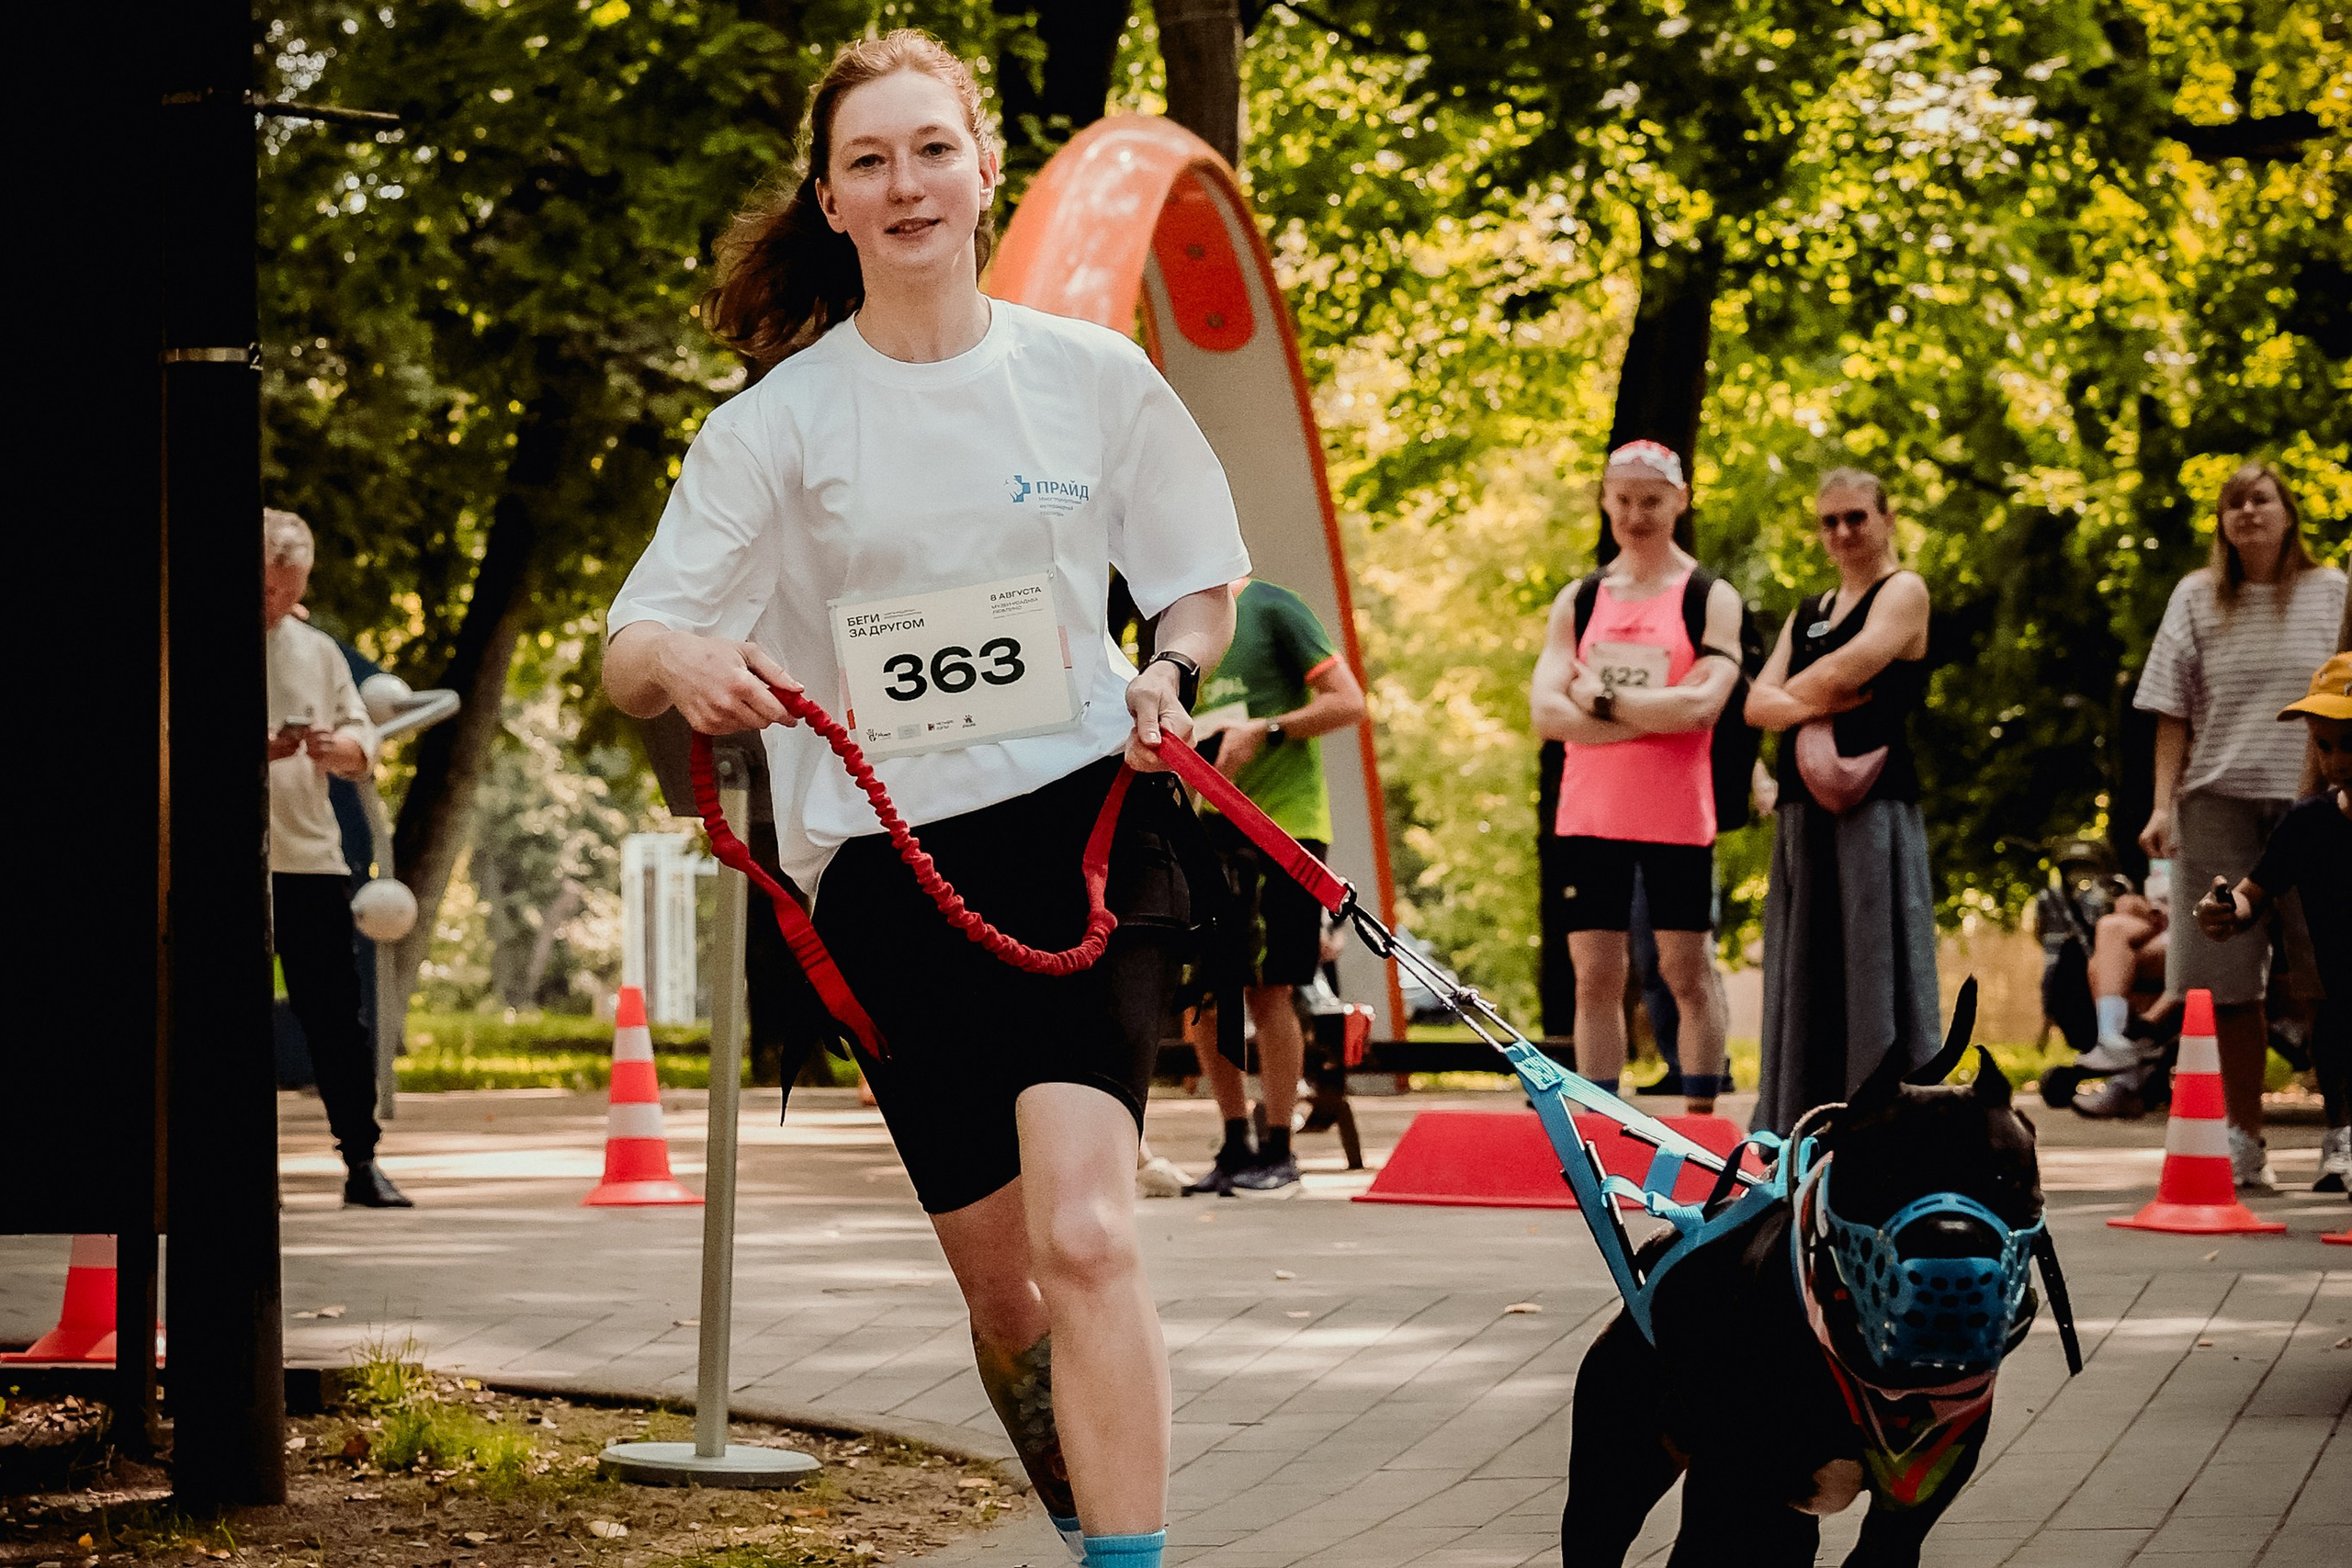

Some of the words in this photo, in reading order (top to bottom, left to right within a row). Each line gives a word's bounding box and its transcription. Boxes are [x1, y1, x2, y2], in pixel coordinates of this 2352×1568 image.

[1036, 479, 1090, 502] ПРАЙД
[989, 593, 997, 602] 8
[999, 586, 1042, 600] АВГУСТА
[847, 614, 880, 626] БЕГИ
[849, 627, 866, 638] ЗА
[869, 618, 924, 637] ДРУГОМ
[883, 637, 1025, 702] 363
